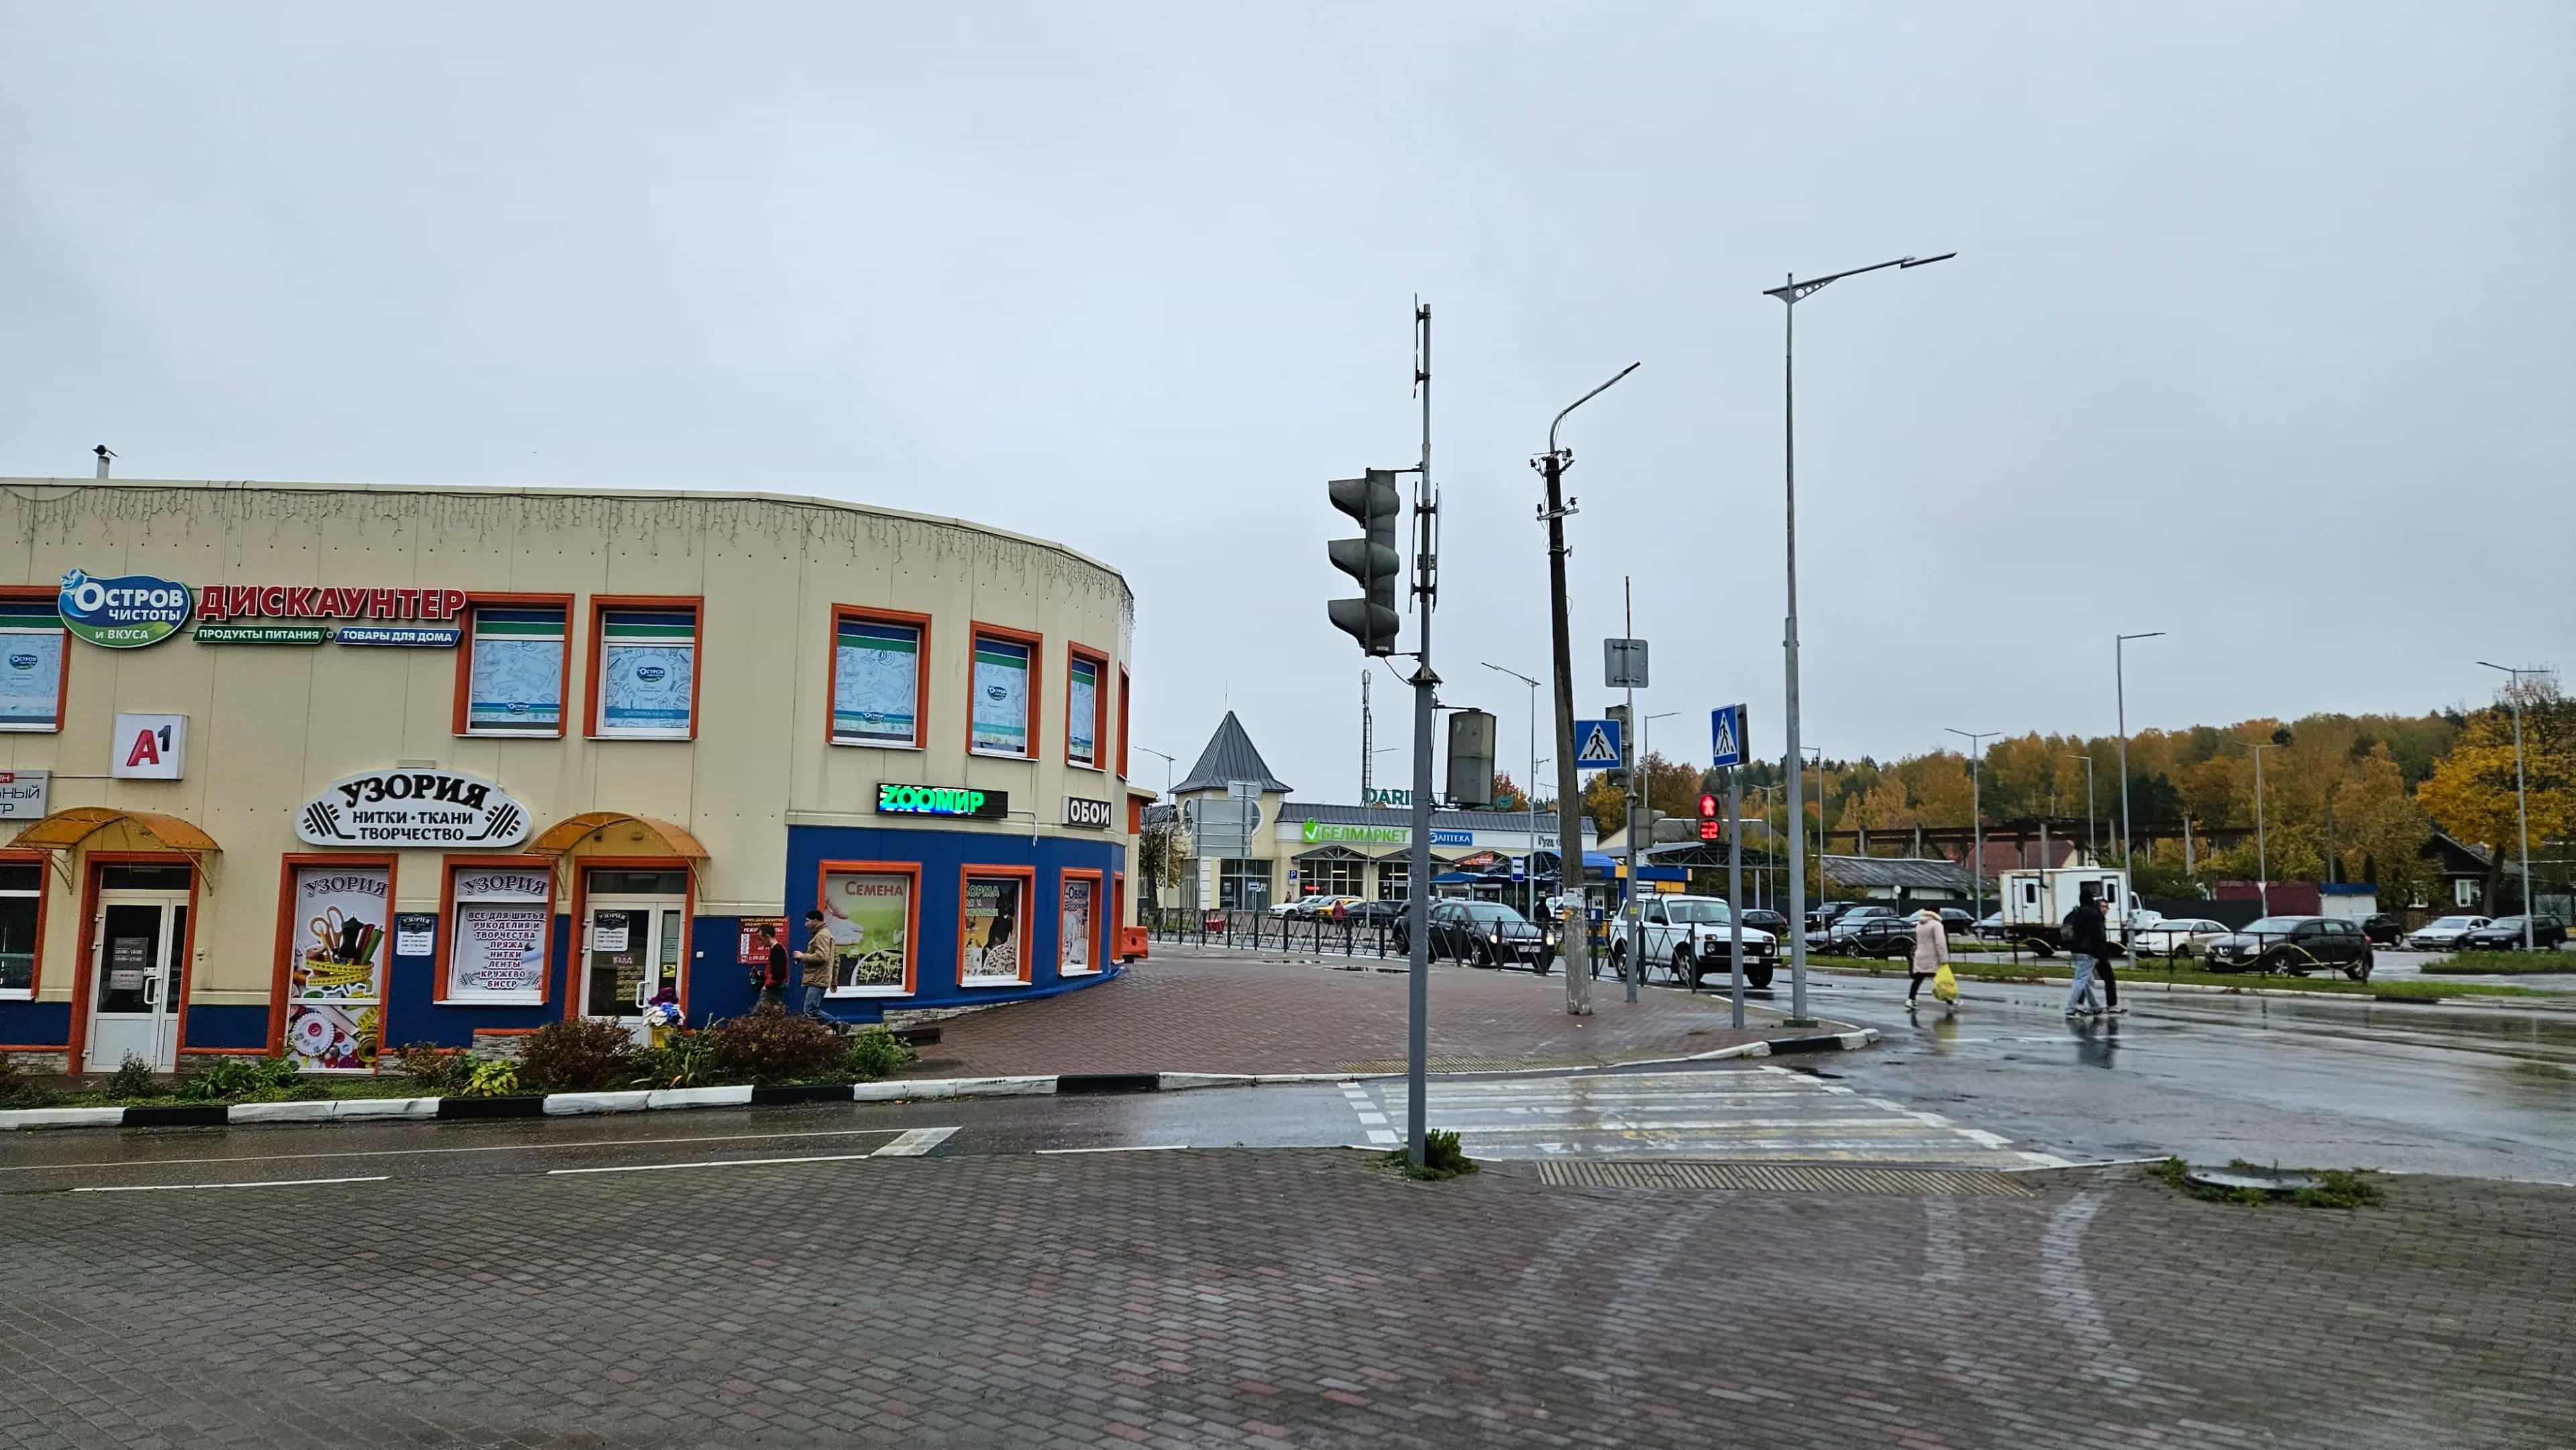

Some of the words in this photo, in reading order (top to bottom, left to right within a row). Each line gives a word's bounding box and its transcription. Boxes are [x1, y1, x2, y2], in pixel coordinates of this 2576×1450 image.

[74, 582, 183, 611] ОСТРОВ
[195, 585, 466, 620] ДИСКАУНТЕР
[109, 609, 180, 620] ЧИСТОТЫ
[107, 630, 149, 639] ВКУСА
[199, 629, 262, 640] ПРОДУКТЫ
[265, 630, 319, 640] ПИТАНИЯ
[343, 630, 389, 640] ТОВАРЫ
[392, 632, 415, 642] ДЛЯ
[417, 633, 452, 642] ДОМА
[338, 774, 491, 811] УЗОРИЯ
[1364, 787, 1412, 805] DARI
[353, 811, 407, 824] НИТКИ
[417, 812, 473, 824] ТКАНИ
[1070, 799, 1110, 825] ОБОИ
[359, 828, 464, 840] ТВОРЧЕСТВО
[1321, 826, 1408, 842] БЕЛМАРКЕТ
[303, 875, 390, 899] УЗОРИЯ
[462, 875, 548, 896] УЗОРИЯ
[845, 880, 903, 897] СЕМЕНА
[468, 912, 485, 920] ВСЕ
[488, 912, 508, 921] ДЛЯ
[474, 922, 530, 930] РУКОДЕЛИЯ
